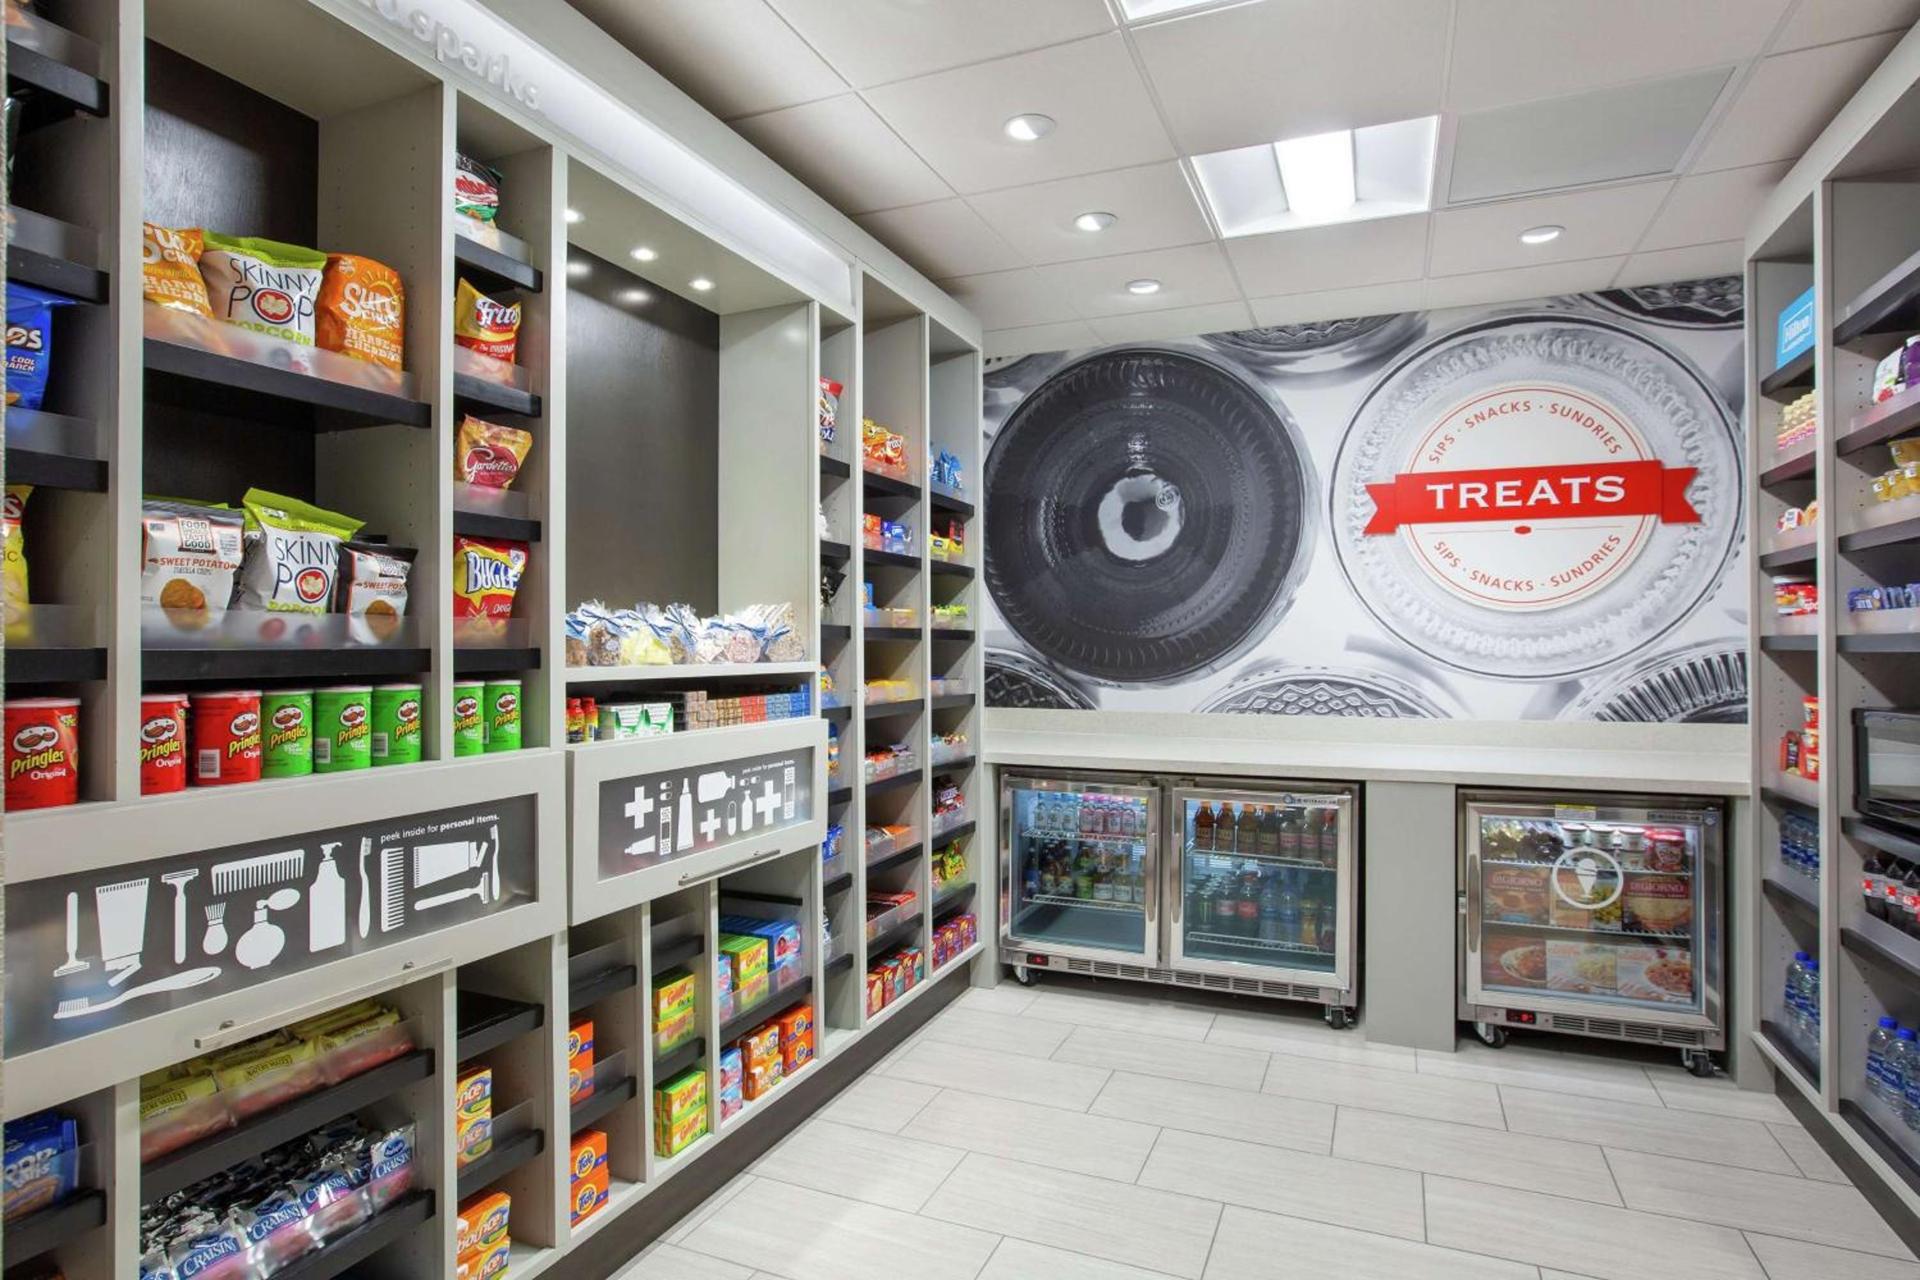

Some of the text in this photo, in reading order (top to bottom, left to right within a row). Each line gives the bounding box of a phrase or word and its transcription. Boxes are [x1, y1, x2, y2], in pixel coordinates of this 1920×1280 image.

[1429, 400, 1623, 464] SIPS SNACKS SUNDRIES
[1425, 475, 1626, 510] TREATS
[160, 557, 230, 570] SWEET POTATO
[1434, 534, 1621, 592] SIPS SNACKS SUNDRIES
[271, 562, 330, 604] PO
[270, 726, 308, 751] Pringles
[10, 748, 65, 779] Pringles
[380, 813, 500, 844] peek inside for personal items.
